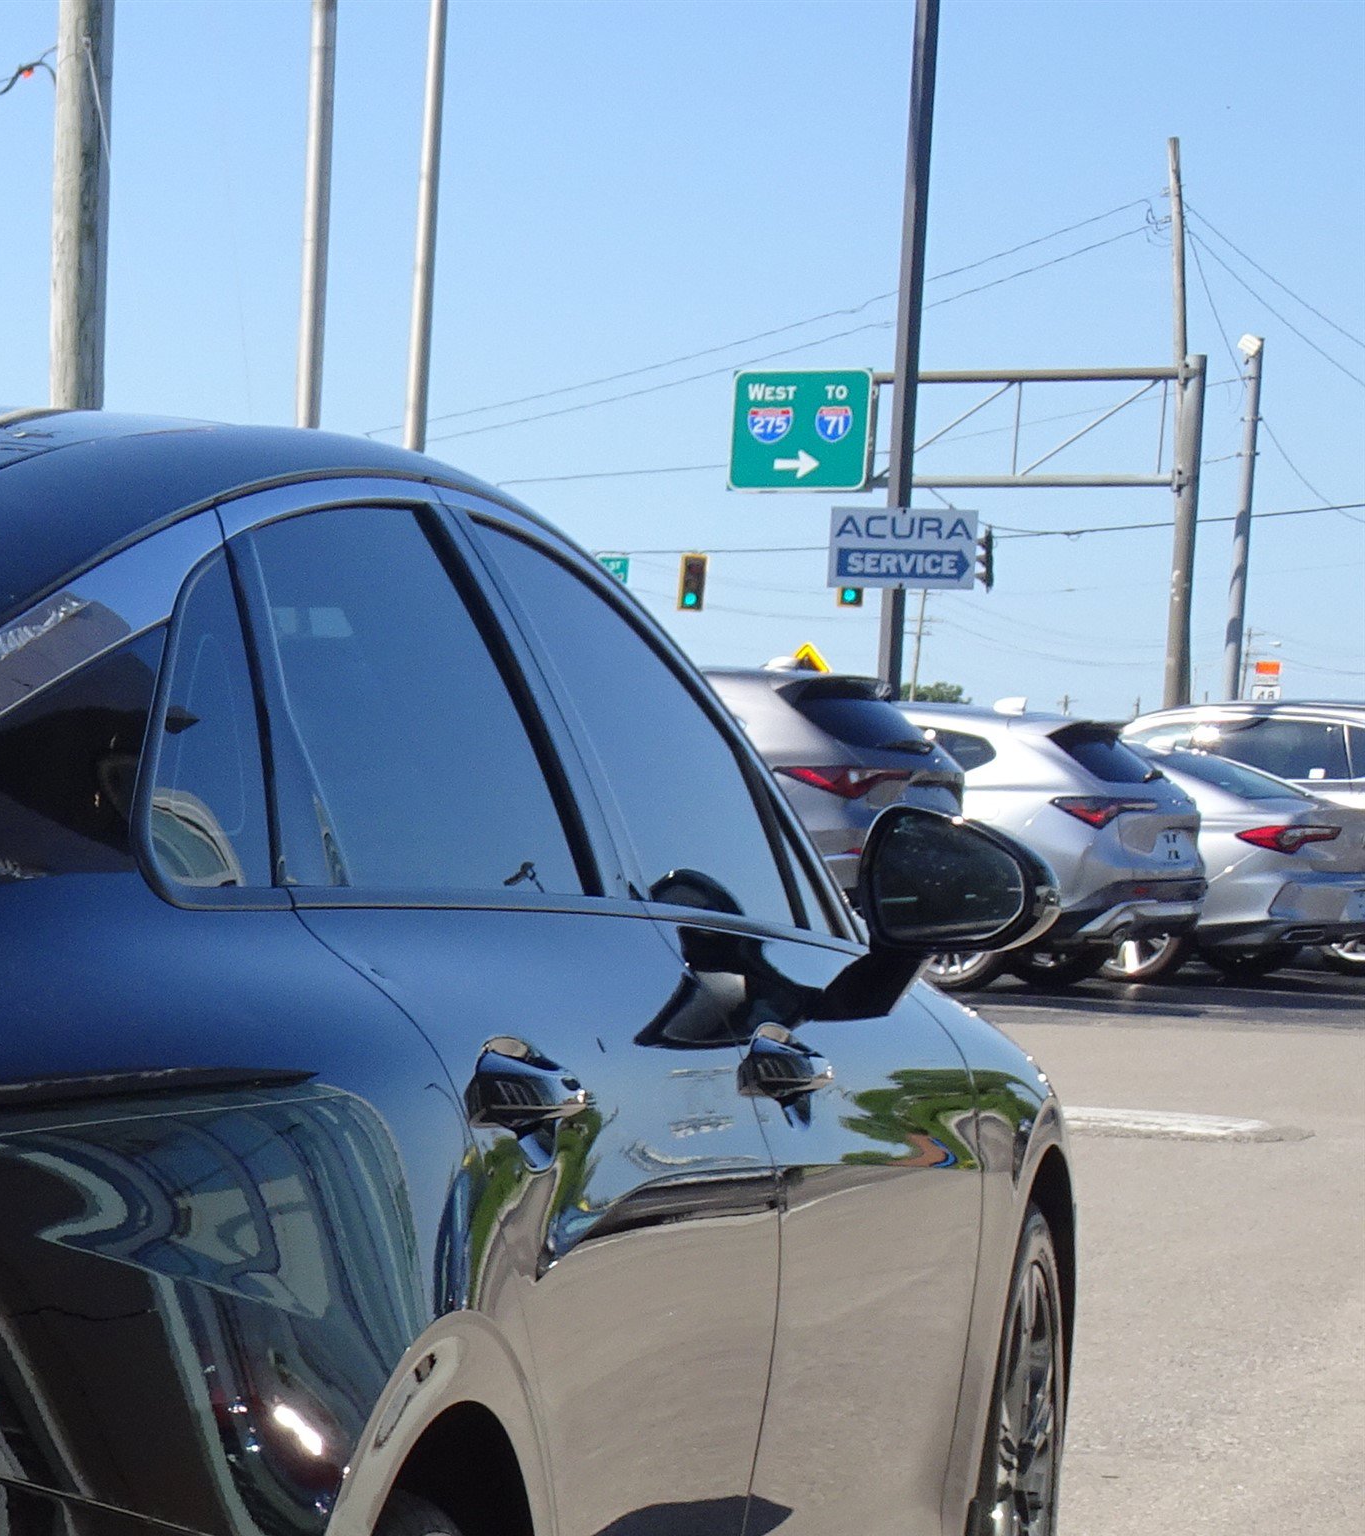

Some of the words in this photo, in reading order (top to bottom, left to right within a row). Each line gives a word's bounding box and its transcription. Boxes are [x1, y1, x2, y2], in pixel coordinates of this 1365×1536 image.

[748, 383, 797, 401] WEST
[824, 385, 848, 400] TO
[752, 416, 787, 433] 275
[824, 415, 845, 435] 71
[835, 515, 973, 540] ACURA
[847, 552, 958, 575] SERVICE
